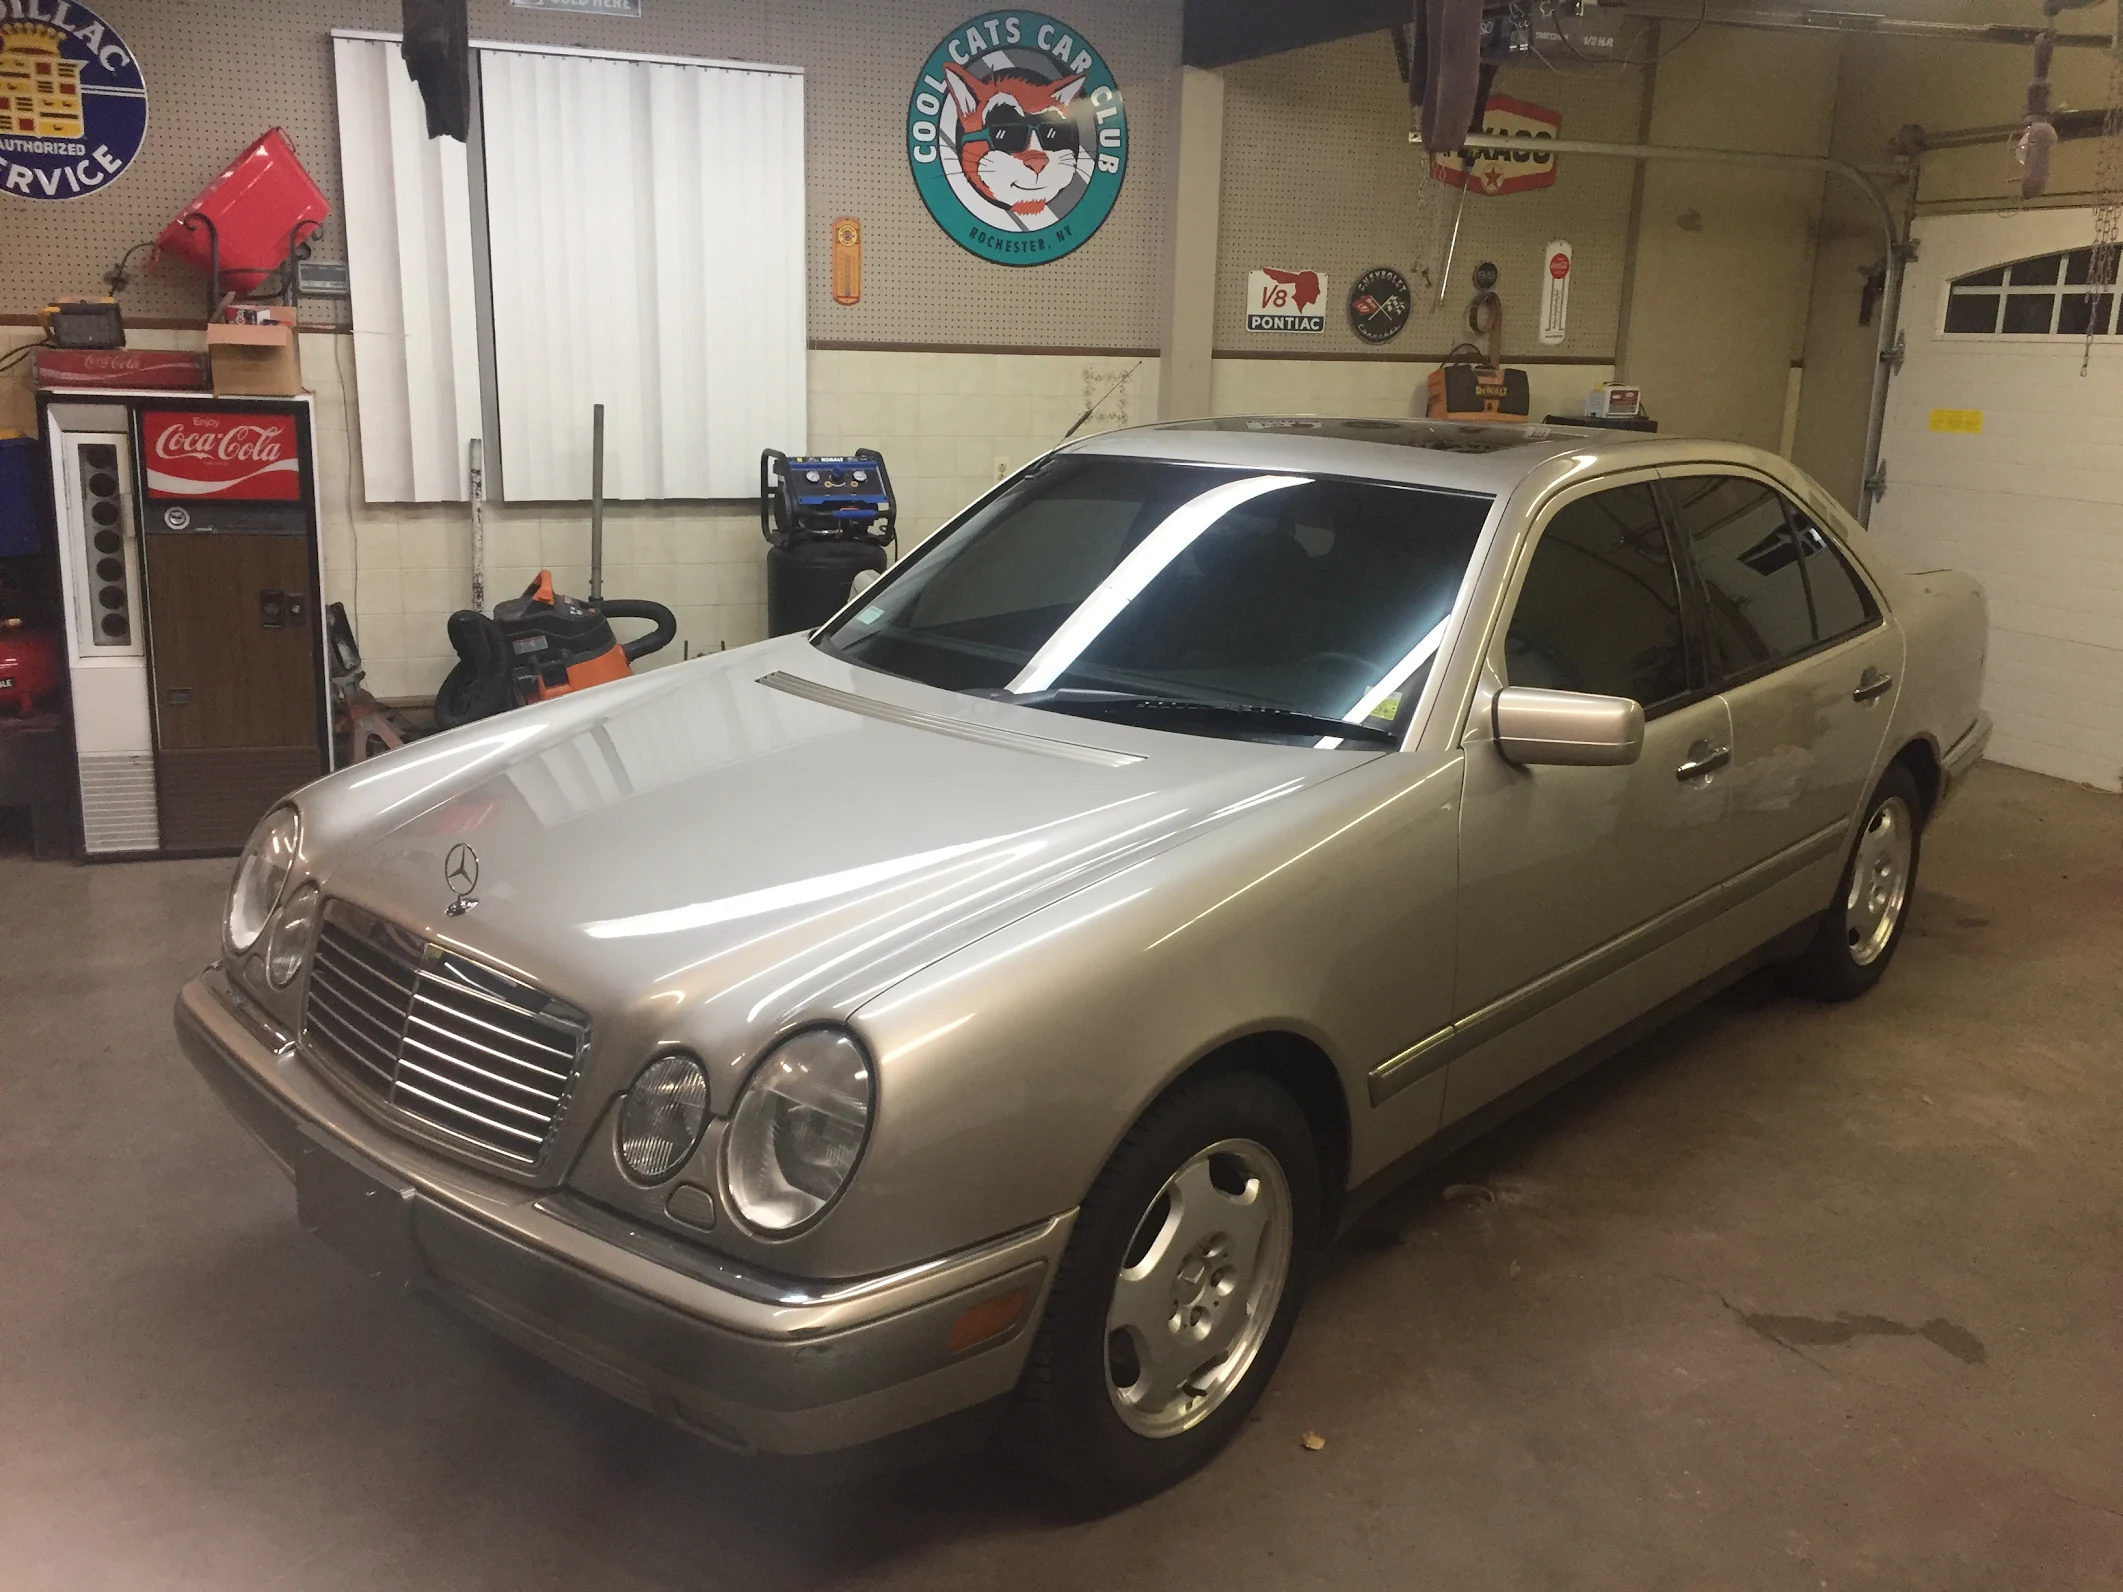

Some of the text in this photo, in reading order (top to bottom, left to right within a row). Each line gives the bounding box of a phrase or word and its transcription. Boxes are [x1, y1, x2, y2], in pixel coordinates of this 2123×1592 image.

[912, 17, 1122, 175] COOL CATS CAR CLUB
[1056, 225, 1073, 243] NY
[1357, 270, 1407, 292] CHEVROLET
[1262, 284, 1288, 309] V8
[1251, 316, 1321, 331] PONTIAC
[193, 416, 220, 428] Enjoy
